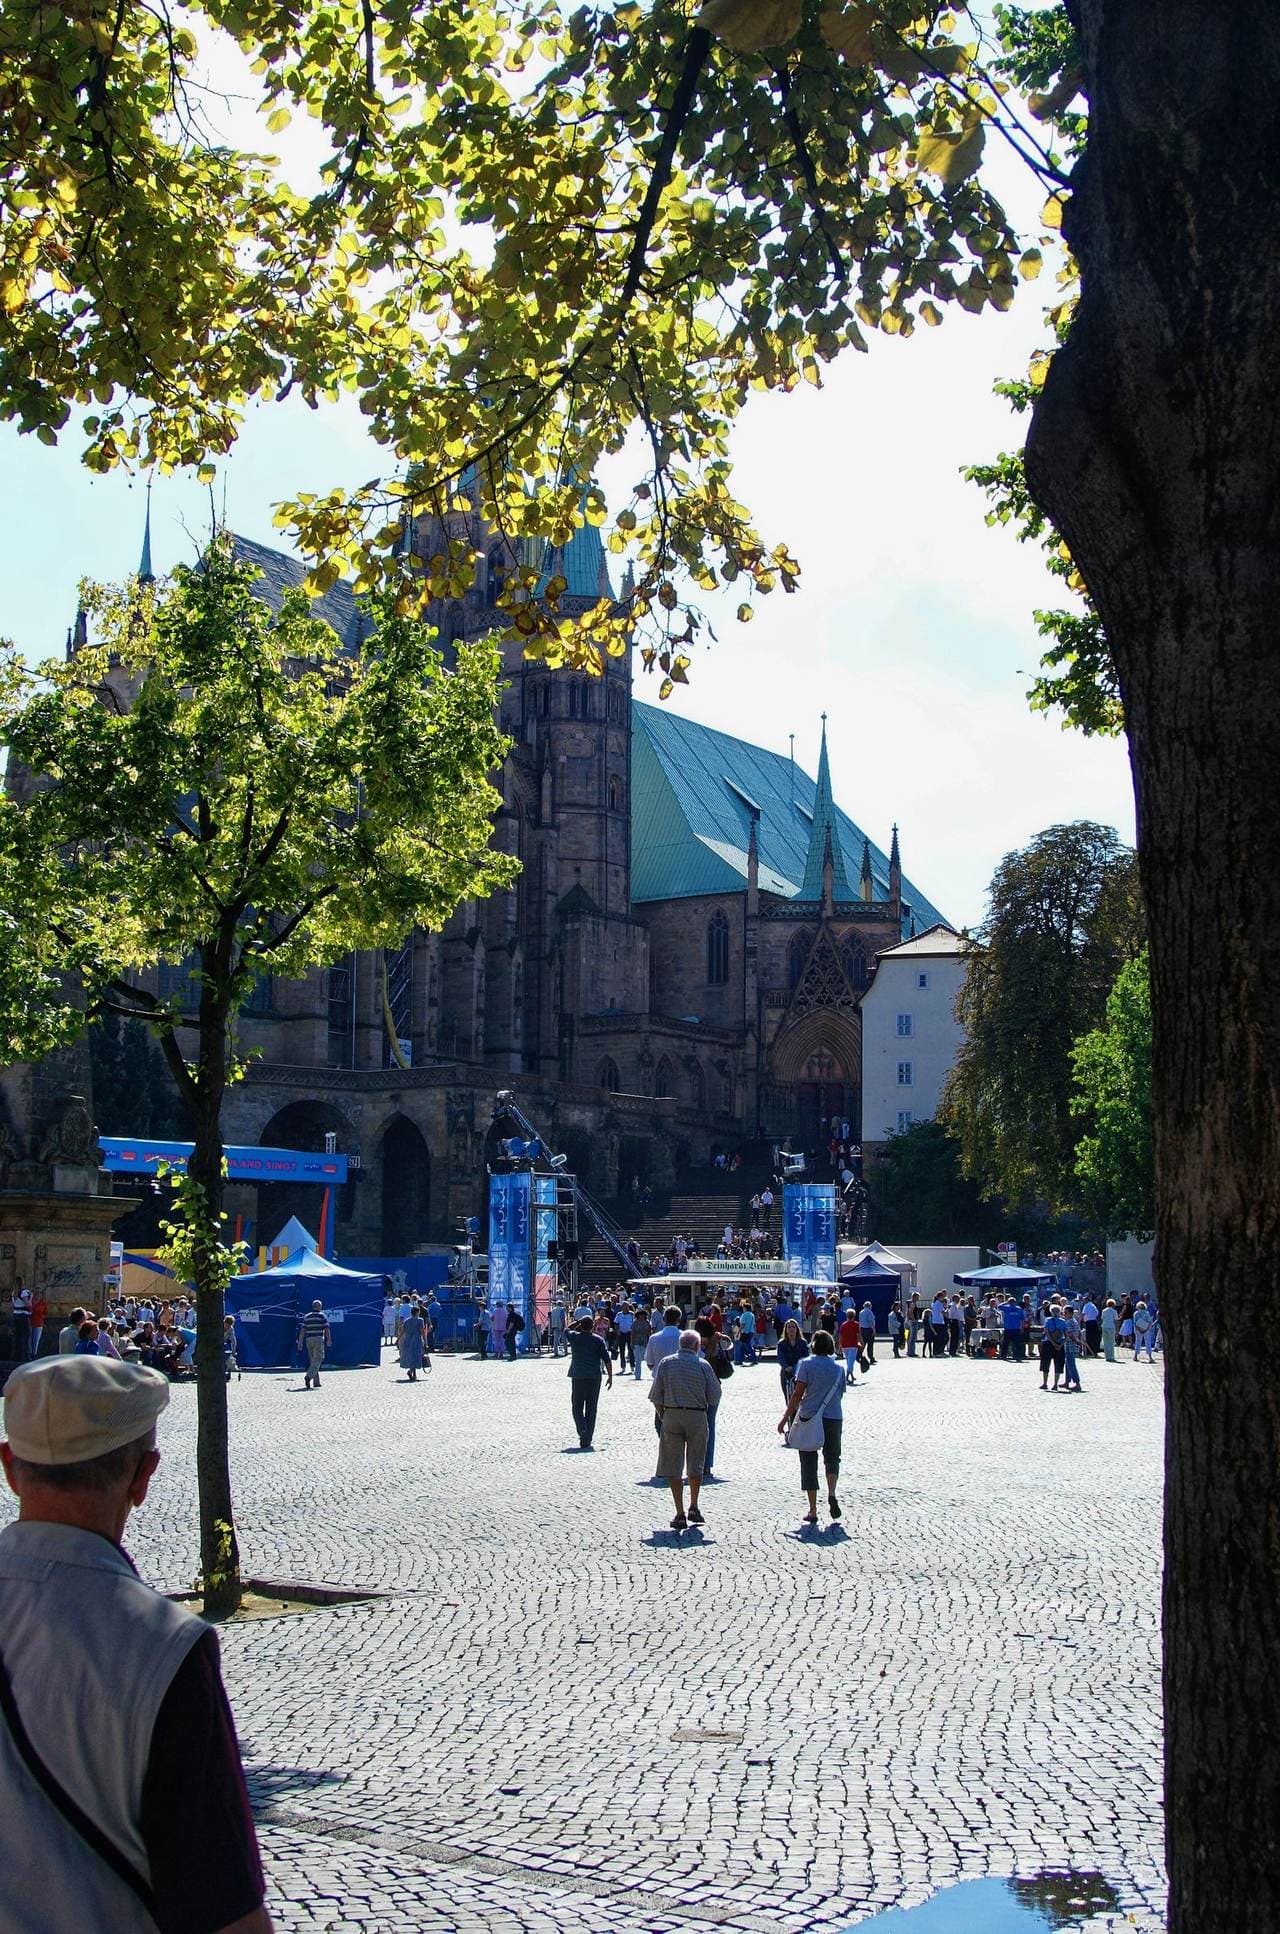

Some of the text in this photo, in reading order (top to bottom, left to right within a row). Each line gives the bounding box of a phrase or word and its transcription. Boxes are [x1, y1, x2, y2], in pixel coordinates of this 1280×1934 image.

[518, 1189, 528, 1234] mdr
[794, 1198, 805, 1235] mdr
[819, 1198, 830, 1235] mdr
